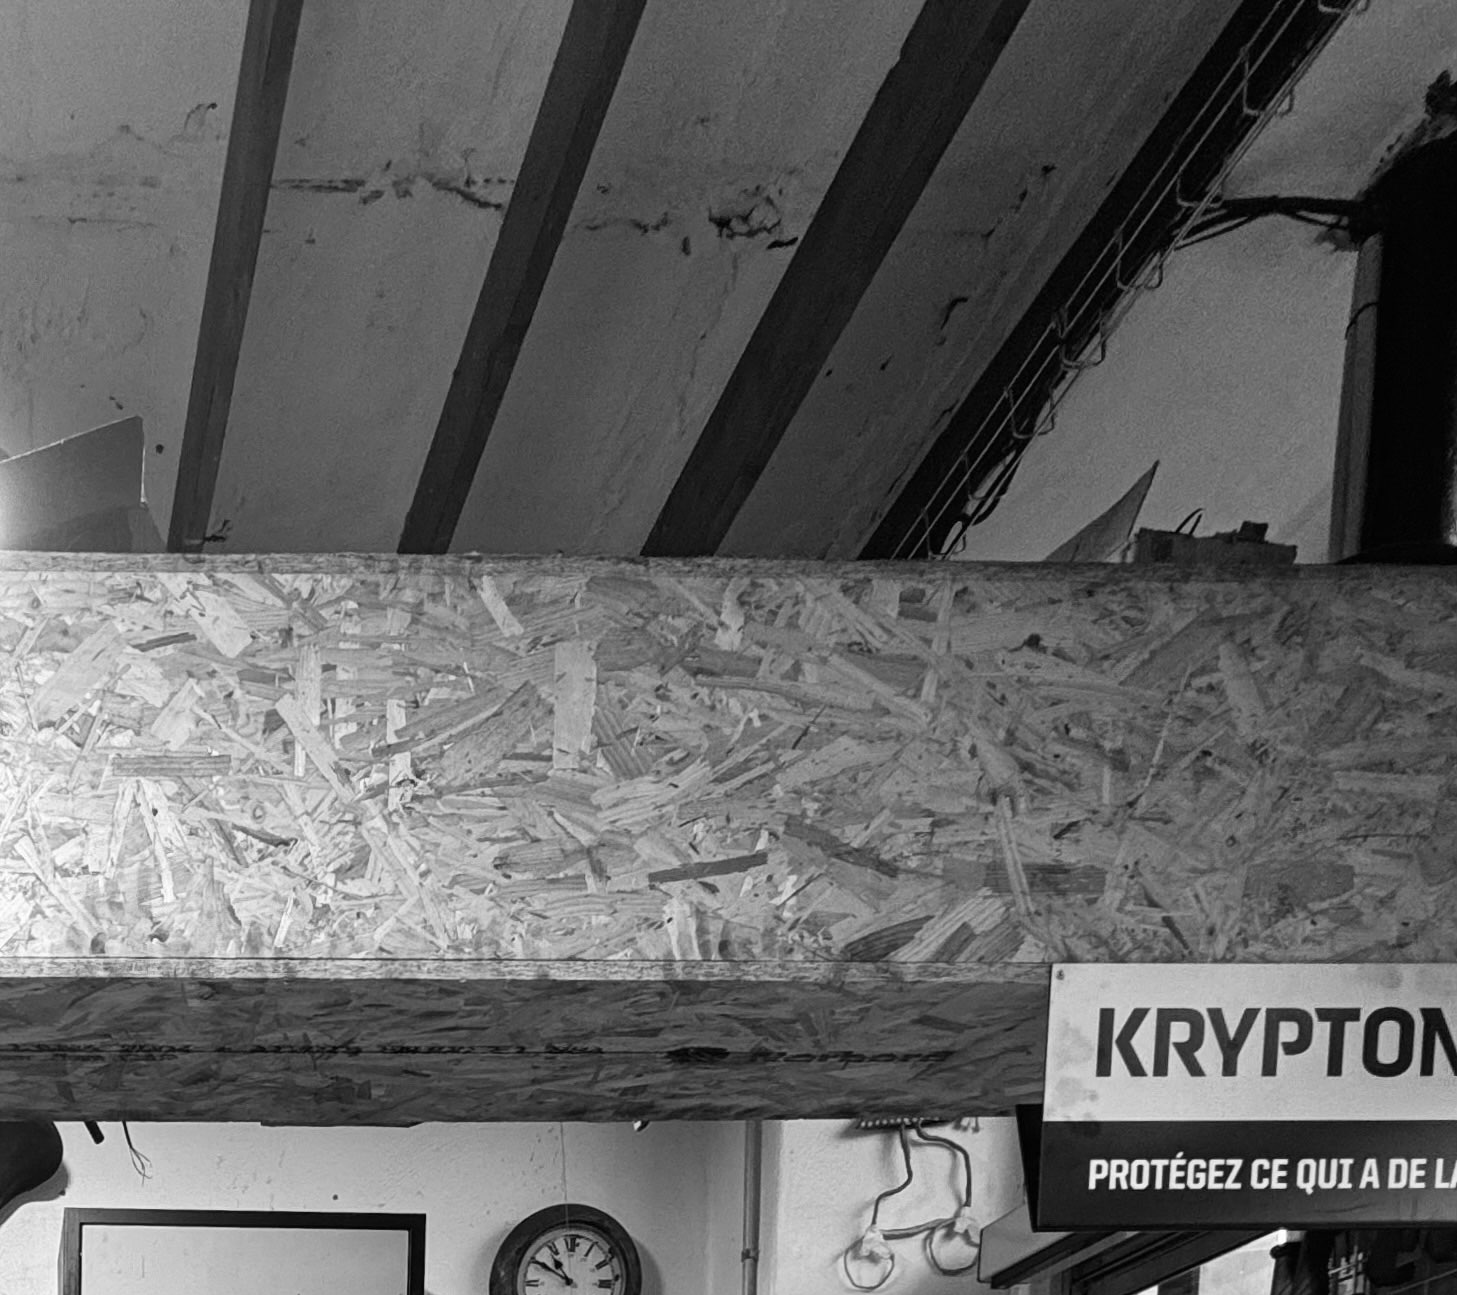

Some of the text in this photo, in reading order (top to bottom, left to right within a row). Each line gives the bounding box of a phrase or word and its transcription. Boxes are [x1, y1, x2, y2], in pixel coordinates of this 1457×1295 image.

[1088, 1151, 1243, 1191] PROTÉGEZ
[1250, 1158, 1288, 1190] CE
[1296, 1158, 1354, 1195] QUI
[1359, 1158, 1380, 1189] A
[1388, 1158, 1427, 1189] DE
